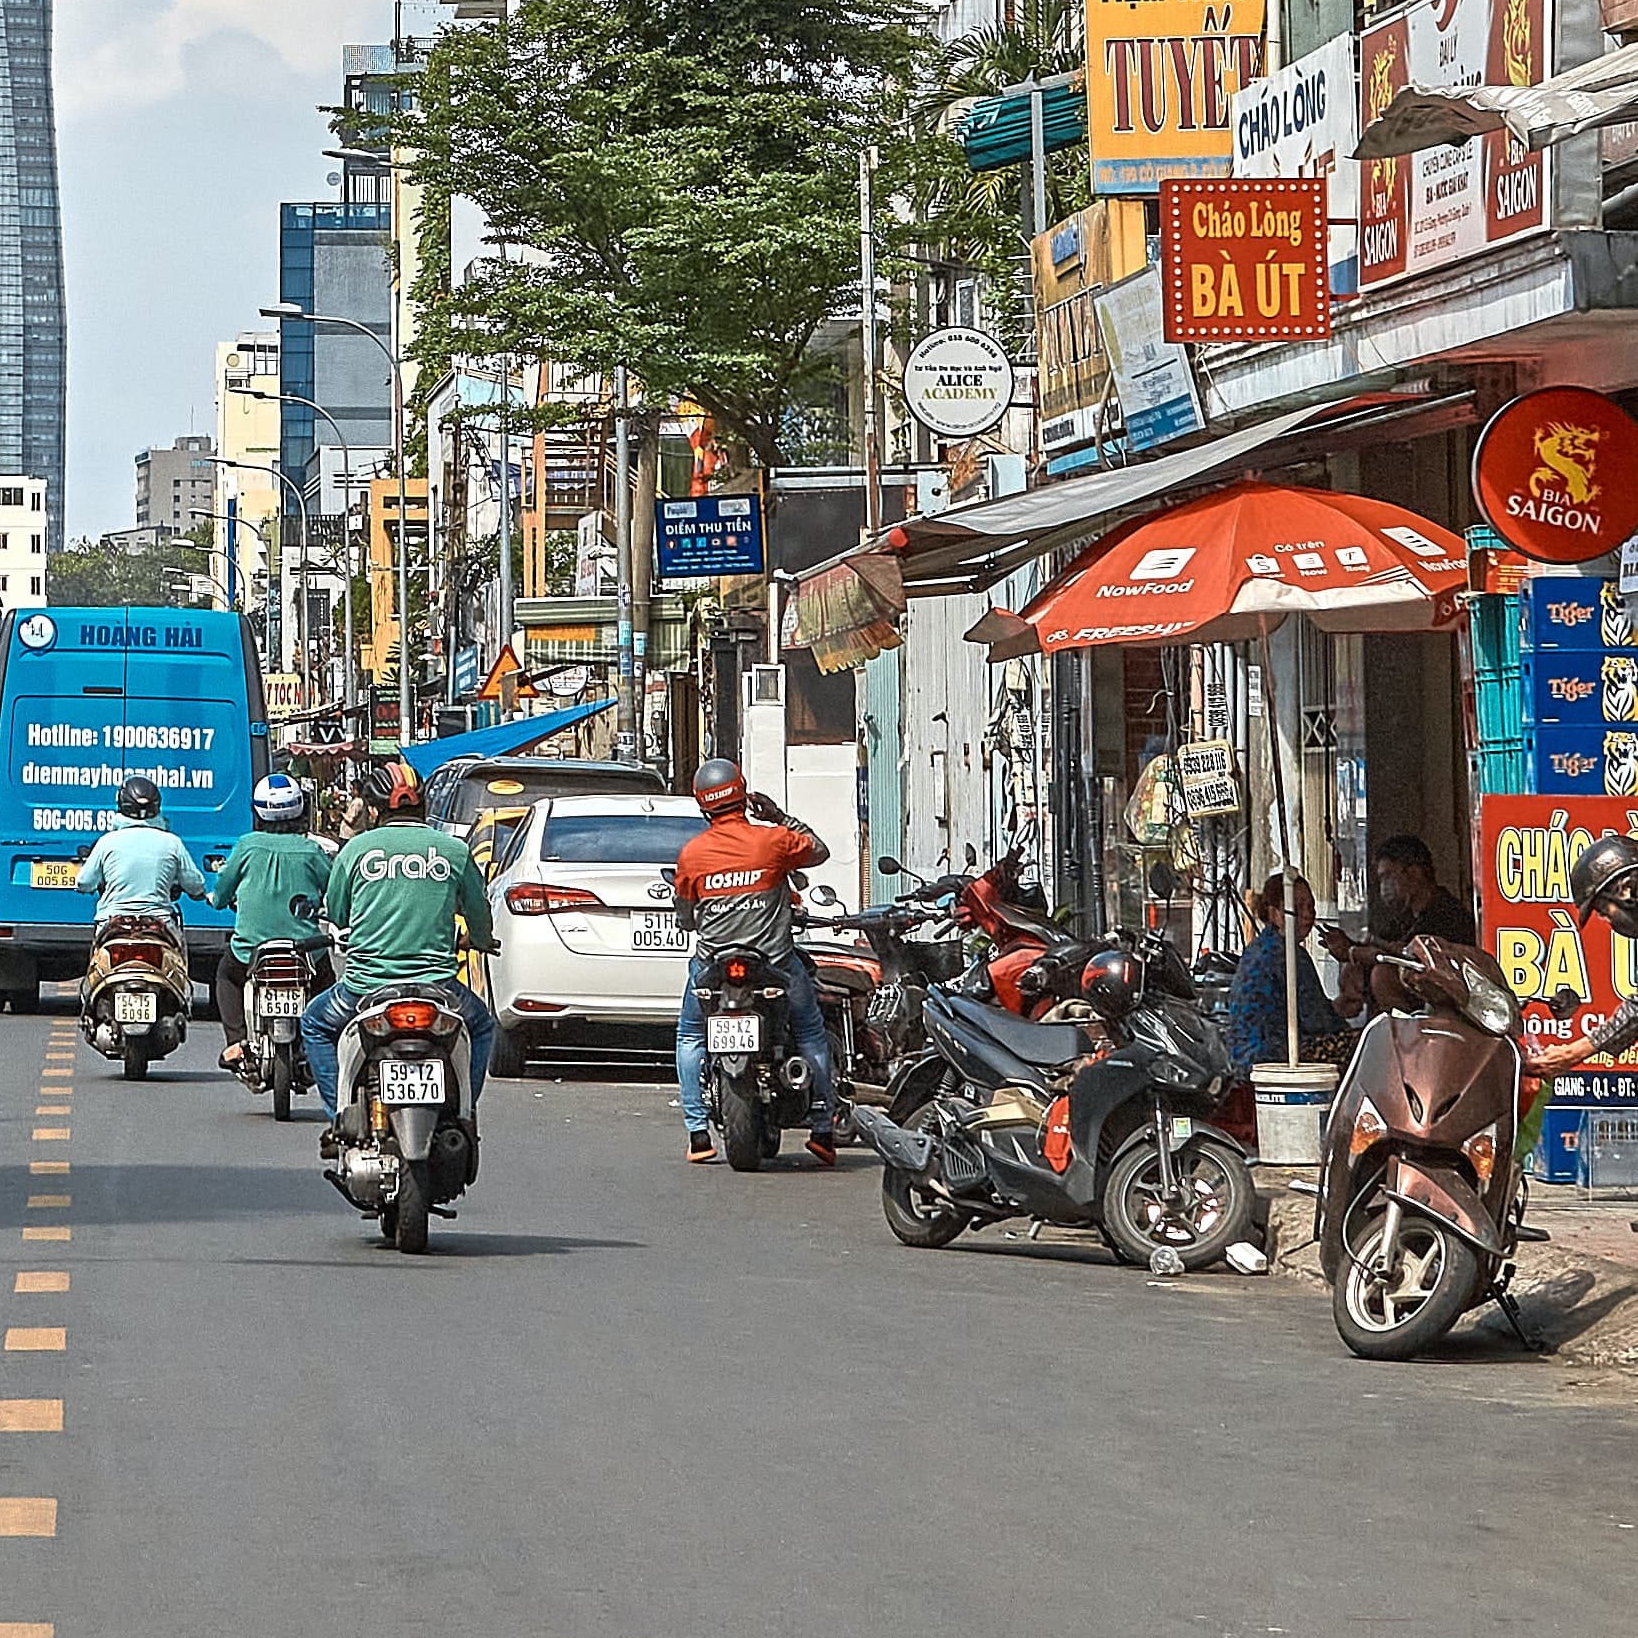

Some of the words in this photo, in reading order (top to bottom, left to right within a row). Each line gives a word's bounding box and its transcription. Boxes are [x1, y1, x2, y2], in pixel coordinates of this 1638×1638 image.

[1239, 86, 1280, 160] CHÁO
[1283, 65, 1326, 136] LÒNG
[1496, 165, 1537, 221] SAIGON
[1193, 201, 1245, 238] Cháo
[1250, 201, 1302, 246] Lòng
[1364, 218, 1398, 267] SAIGON
[1191, 249, 1244, 318] BÀ
[1256, 249, 1306, 318] ÚT
[936, 374, 983, 387] ALICE
[922, 388, 997, 400] ACADEMY
[1543, 488, 1571, 507] BIA
[1506, 495, 1601, 535] SAIGON
[699, 522, 723, 533] THU
[1096, 578, 1196, 599] NowFood
[1547, 602, 1595, 627] Tiger
[80, 620, 157, 647] HOÀNG
[164, 621, 203, 648] HẢI
[1072, 621, 1196, 641] FREESHI
[1548, 677, 1596, 702] Tiger
[28, 723, 99, 748] Hotline:
[102, 724, 215, 750] 1900636917
[1549, 753, 1598, 778] Tiger
[45, 864, 68, 875] 50G
[359, 846, 452, 882] Grab
[37, 876, 76, 887] 005.69
[704, 869, 764, 890] LOSHIP
[633, 930, 685, 947] 005.40
[1497, 909, 1592, 1003] BÀ
[122, 1008, 150, 1020] 5096
[715, 1019, 752, 1034] 59-K2
[712, 1034, 755, 1050] 699.46
[389, 1064, 434, 1082] 59-T2
[386, 1083, 439, 1101] 536.70
[1554, 1076, 1585, 1097] GIANG
